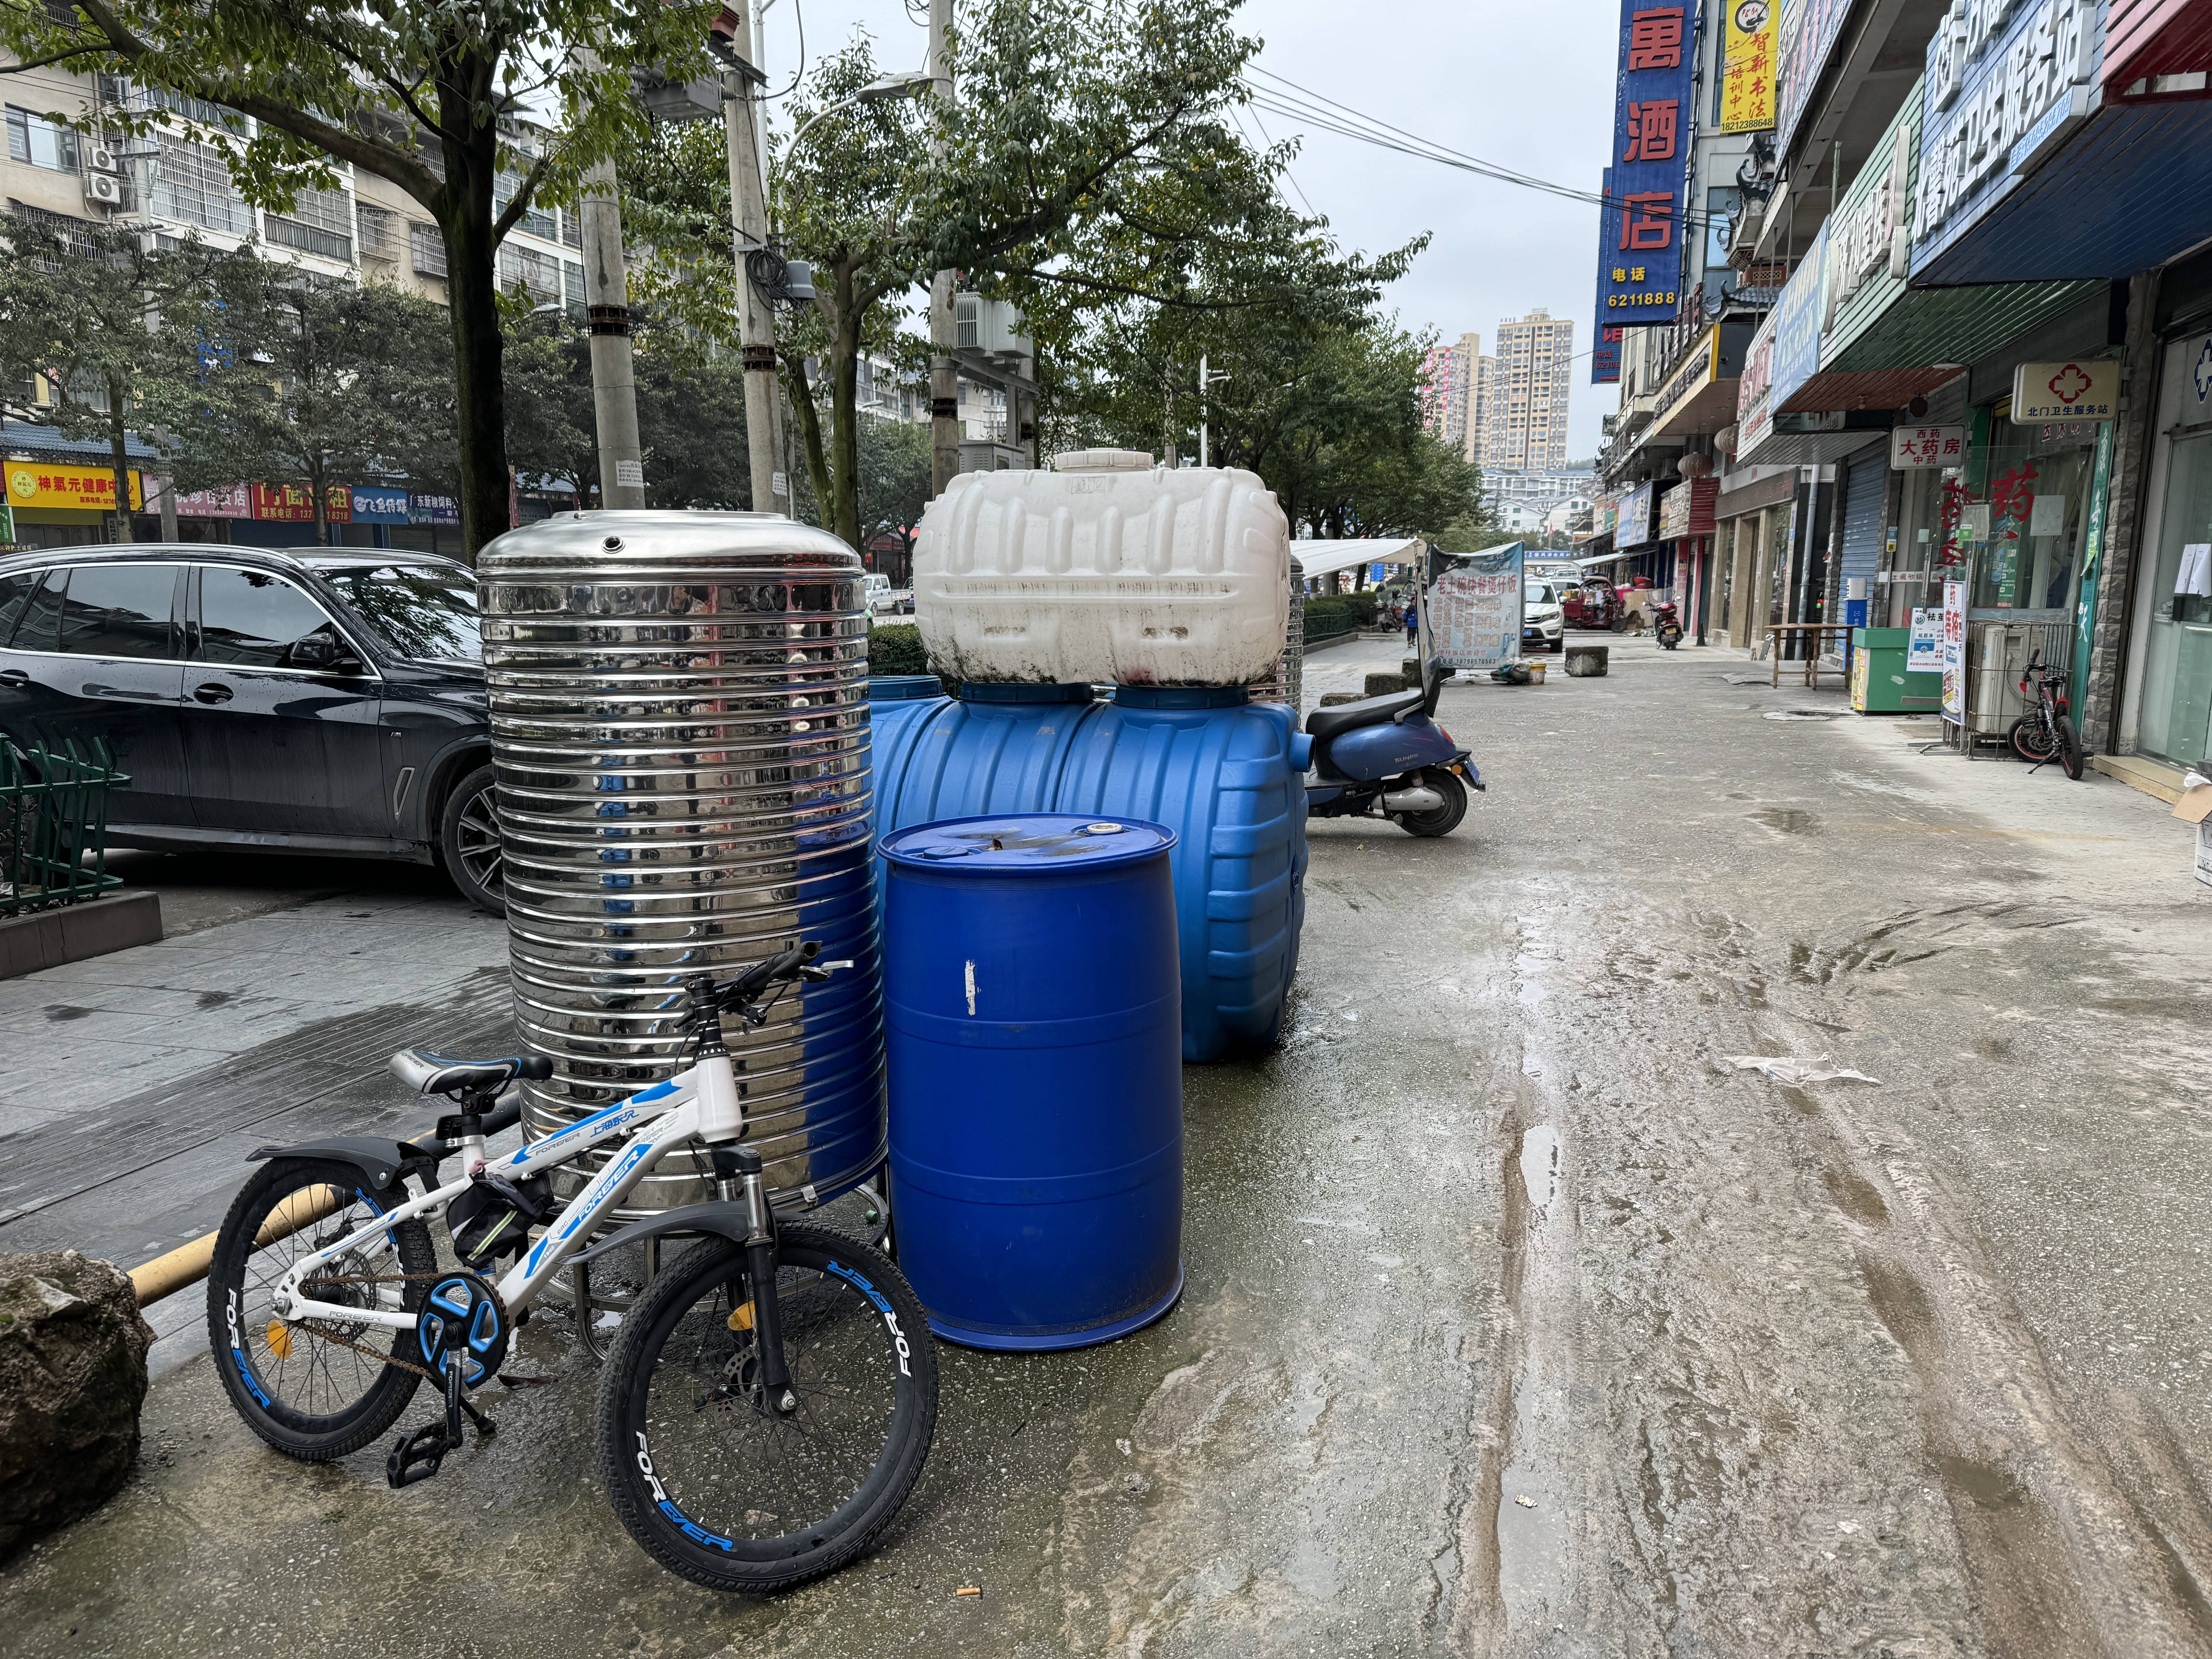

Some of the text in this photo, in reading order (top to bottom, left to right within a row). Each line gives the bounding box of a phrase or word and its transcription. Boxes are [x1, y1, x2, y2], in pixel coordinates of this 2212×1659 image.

[1747, 32, 1771, 119] 智新书法
[1727, 66, 1744, 120] 培训中心
[1618, 7, 1685, 250] 寓酒店
[1721, 118, 1772, 131] 18212388648
[1612, 267, 1645, 282] 电话
[1608, 292, 1674, 307] 6211888
[2028, 404, 2108, 416] 北门卫生服务站
[1917, 429, 1940, 438] 西药
[1900, 438, 1960, 455] 大药房
[1914, 455, 1937, 464] 中药
[365, 498, 407, 514] 飞鱼传媒
